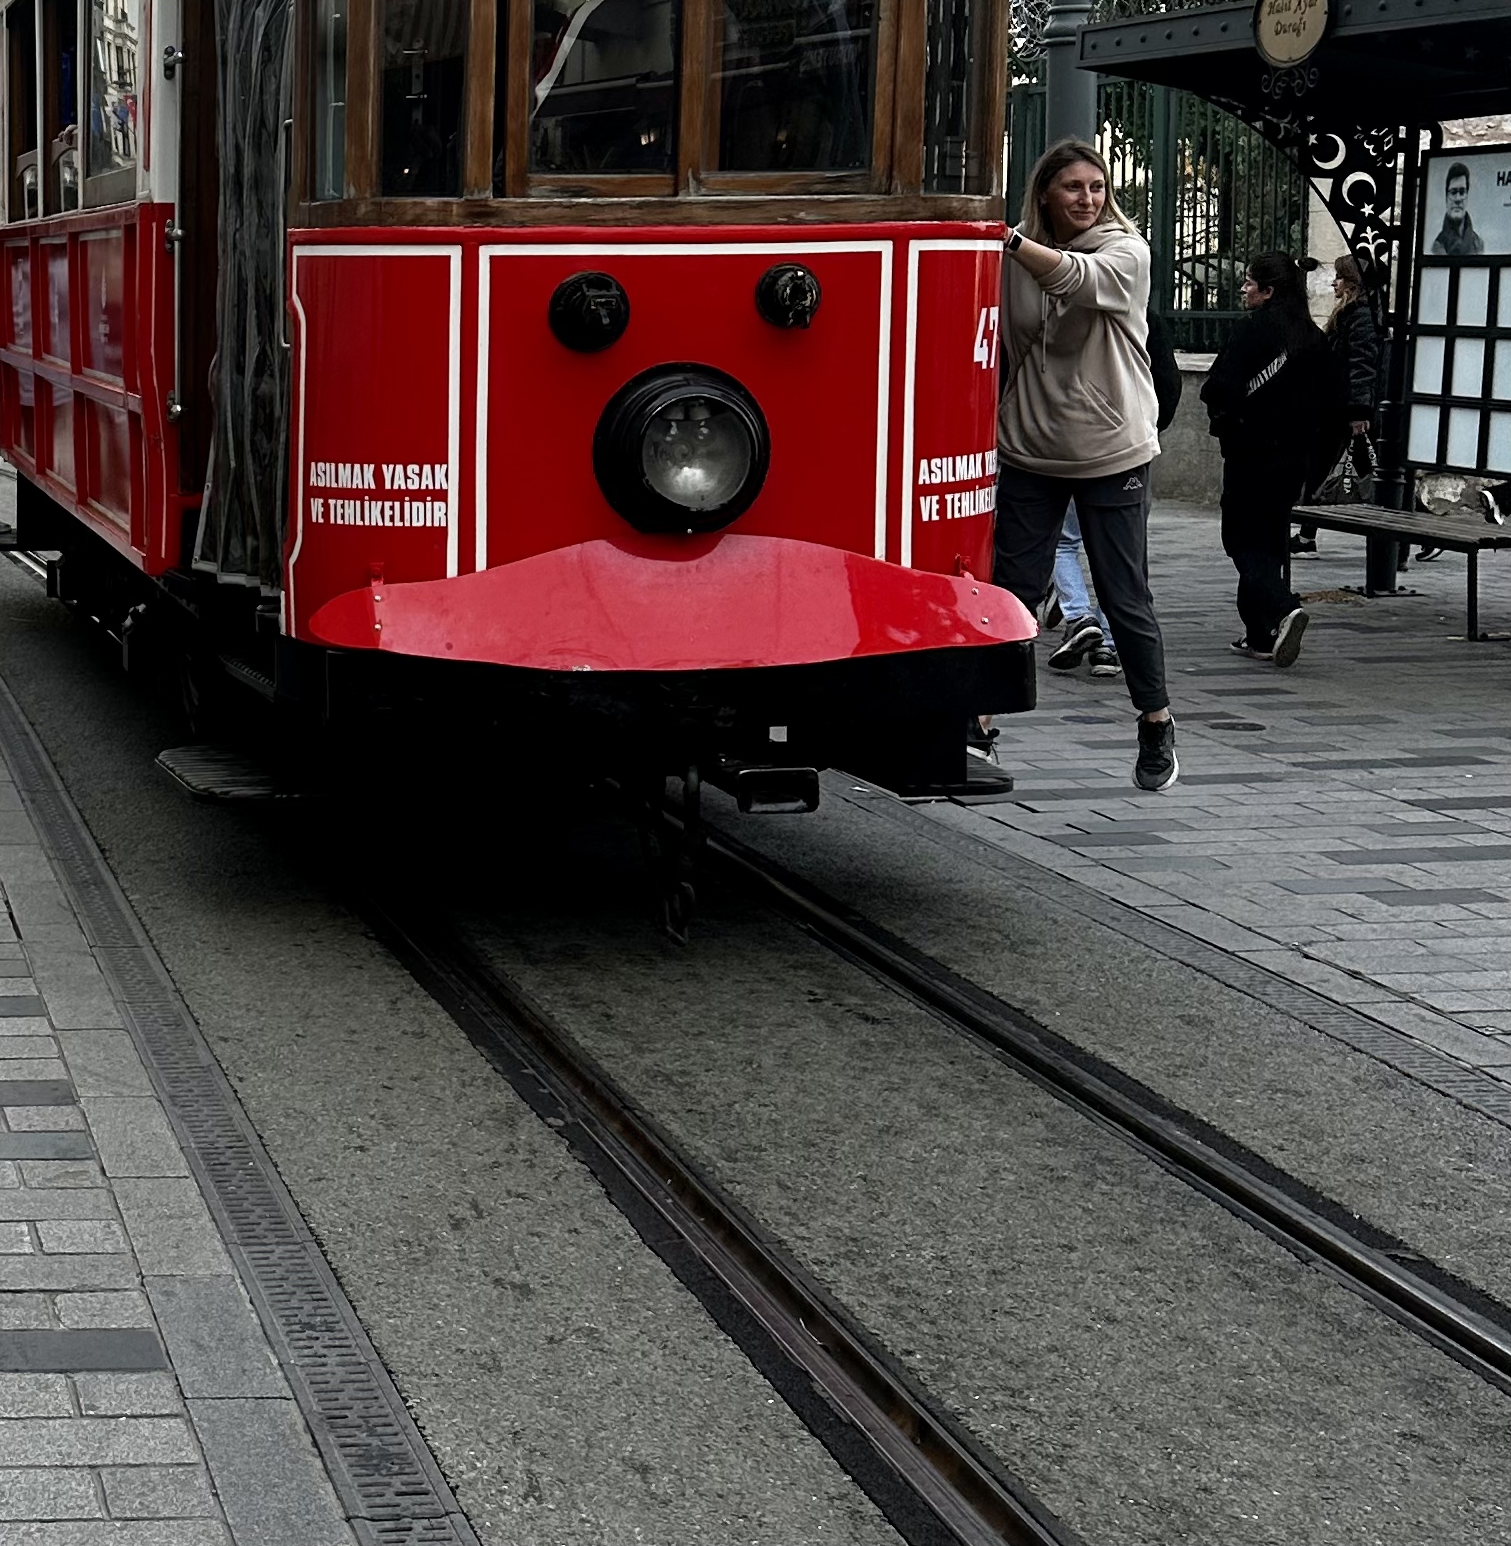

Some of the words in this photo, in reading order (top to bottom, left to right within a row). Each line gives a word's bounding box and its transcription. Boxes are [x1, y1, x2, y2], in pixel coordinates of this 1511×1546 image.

[973, 305, 1000, 370] 47
[309, 461, 376, 490] ASILMAK
[381, 463, 449, 490] YASAK
[917, 452, 983, 486] ASILMAK
[310, 497, 325, 524] VE
[327, 495, 448, 528] TEHLİKELİDİR
[919, 495, 940, 522] VE
